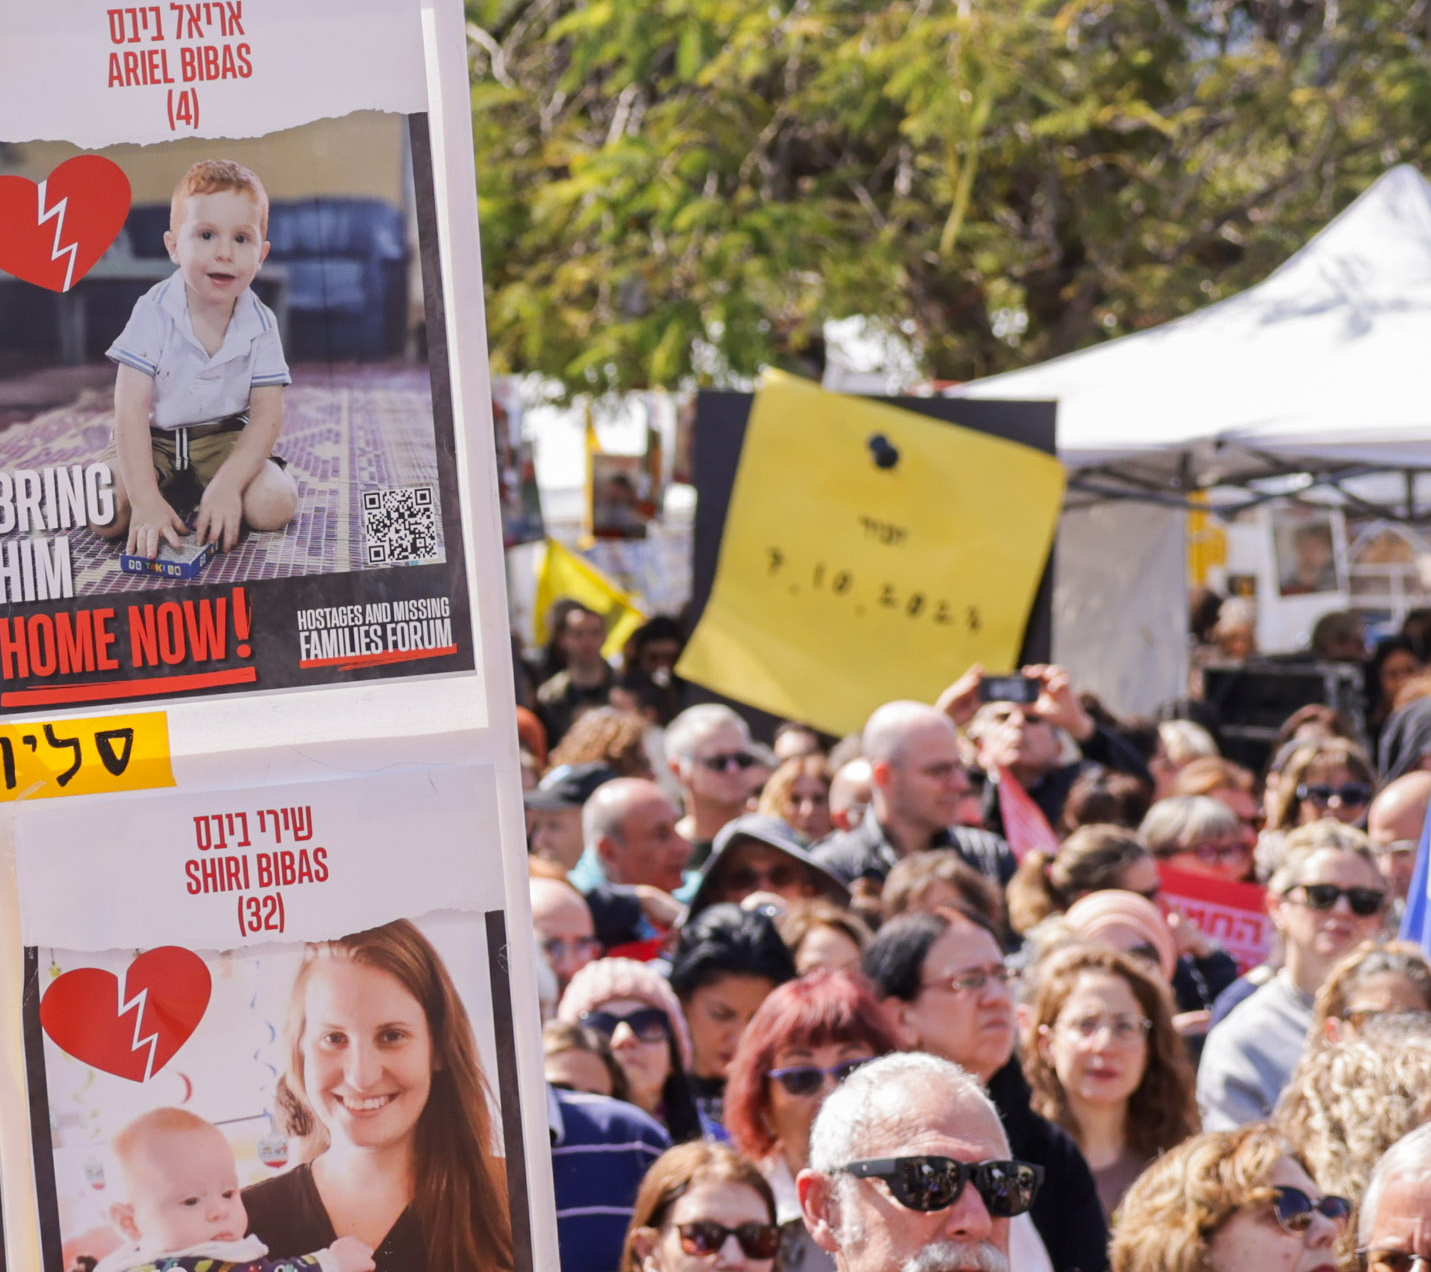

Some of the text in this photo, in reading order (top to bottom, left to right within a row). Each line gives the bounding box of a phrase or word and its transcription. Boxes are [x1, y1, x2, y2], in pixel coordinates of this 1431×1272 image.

[107, 0, 245, 44] אריאל ביבס
[108, 42, 253, 88] ARIEL BIBAS
[167, 87, 199, 131] (4)
[127, 587, 253, 667] NOW!
[297, 597, 450, 631] HOSTAGES AND MISSING
[299, 617, 453, 661] FAMILIES FORUM
[193, 805, 313, 851] שירי ביבס
[185, 846, 329, 895] SHIRI BIBAS
[238, 892, 285, 937] (32)
